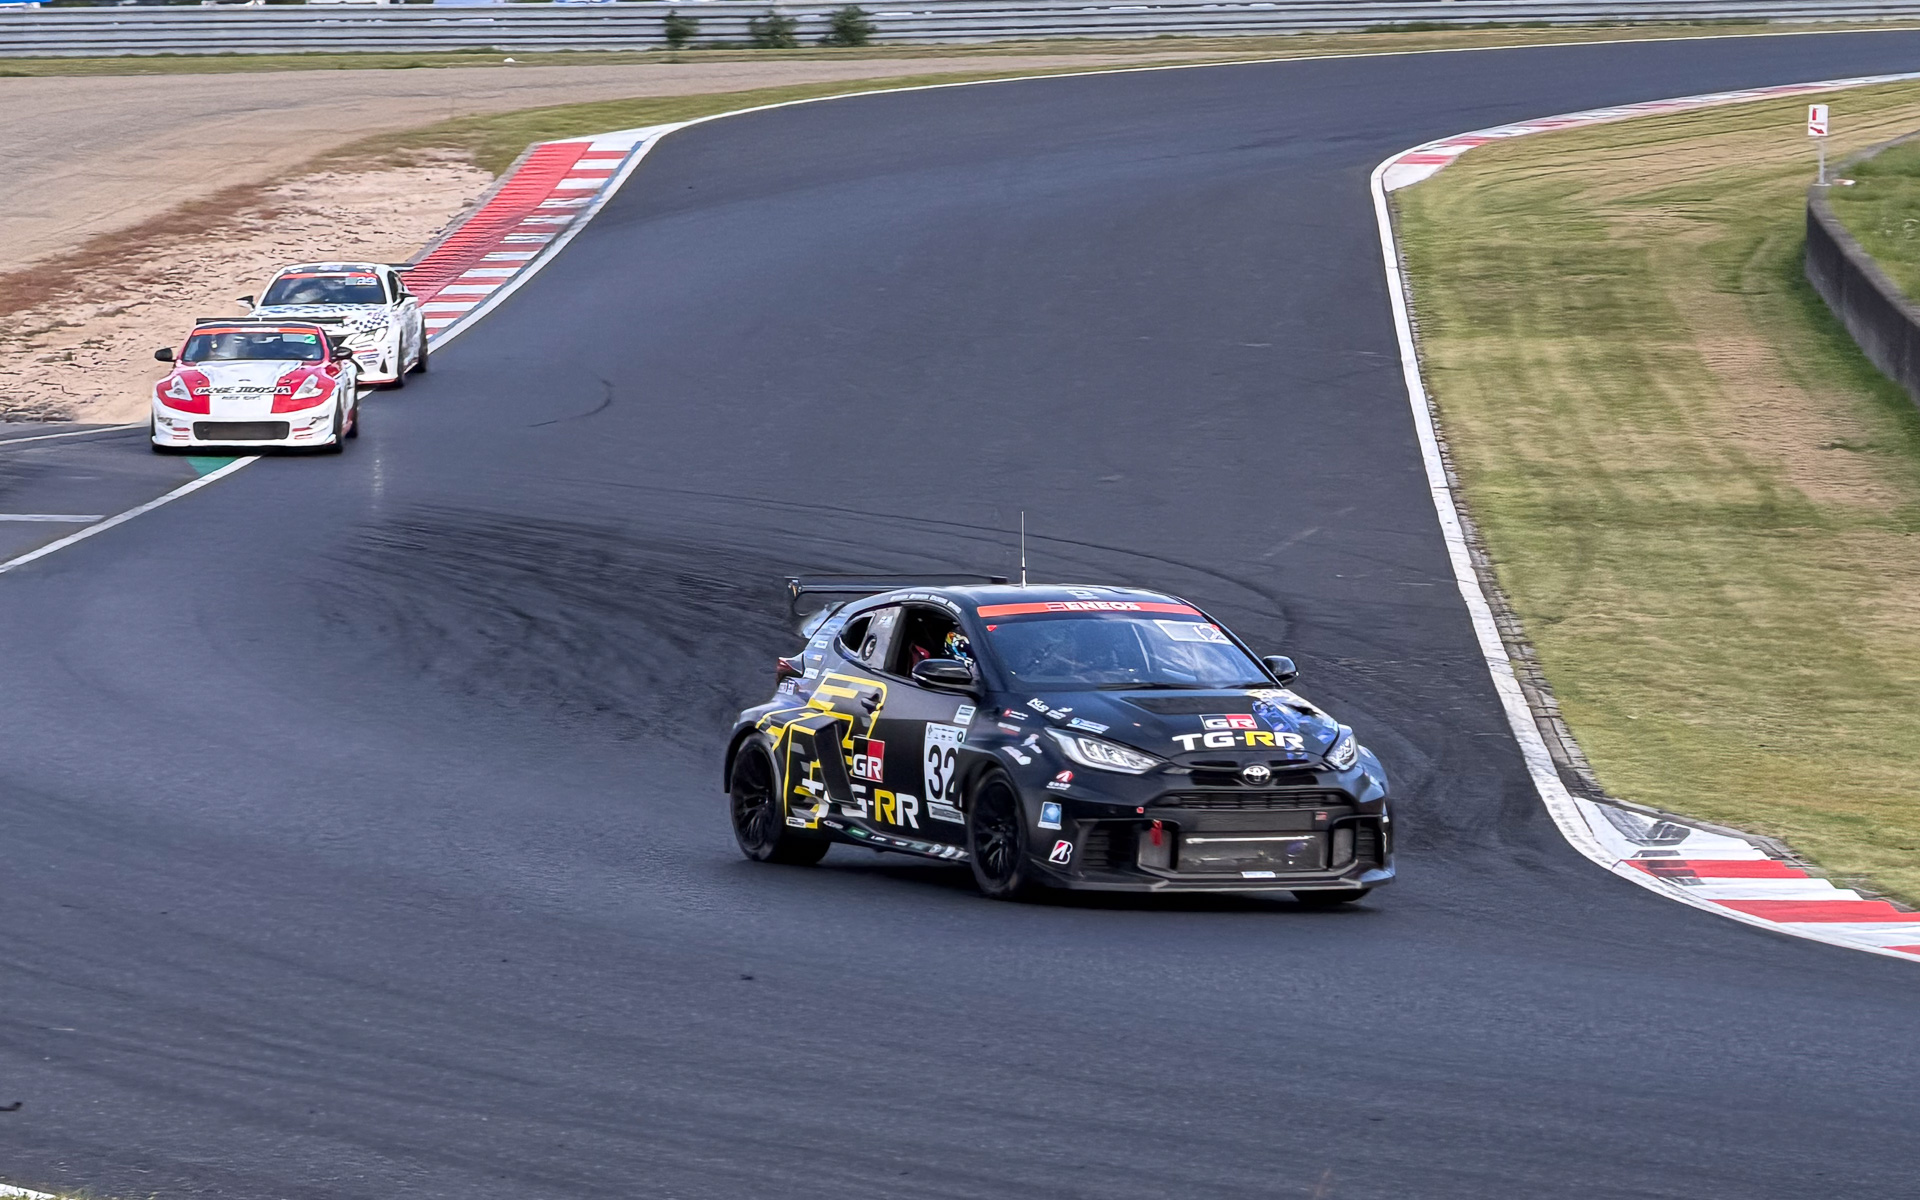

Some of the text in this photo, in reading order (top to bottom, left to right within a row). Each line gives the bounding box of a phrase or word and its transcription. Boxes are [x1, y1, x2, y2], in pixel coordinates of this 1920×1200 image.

[1065, 602, 1141, 611] ENEOS
[1172, 731, 1305, 751] TG-RR
[853, 753, 882, 779] GR
[928, 745, 957, 801] 32
